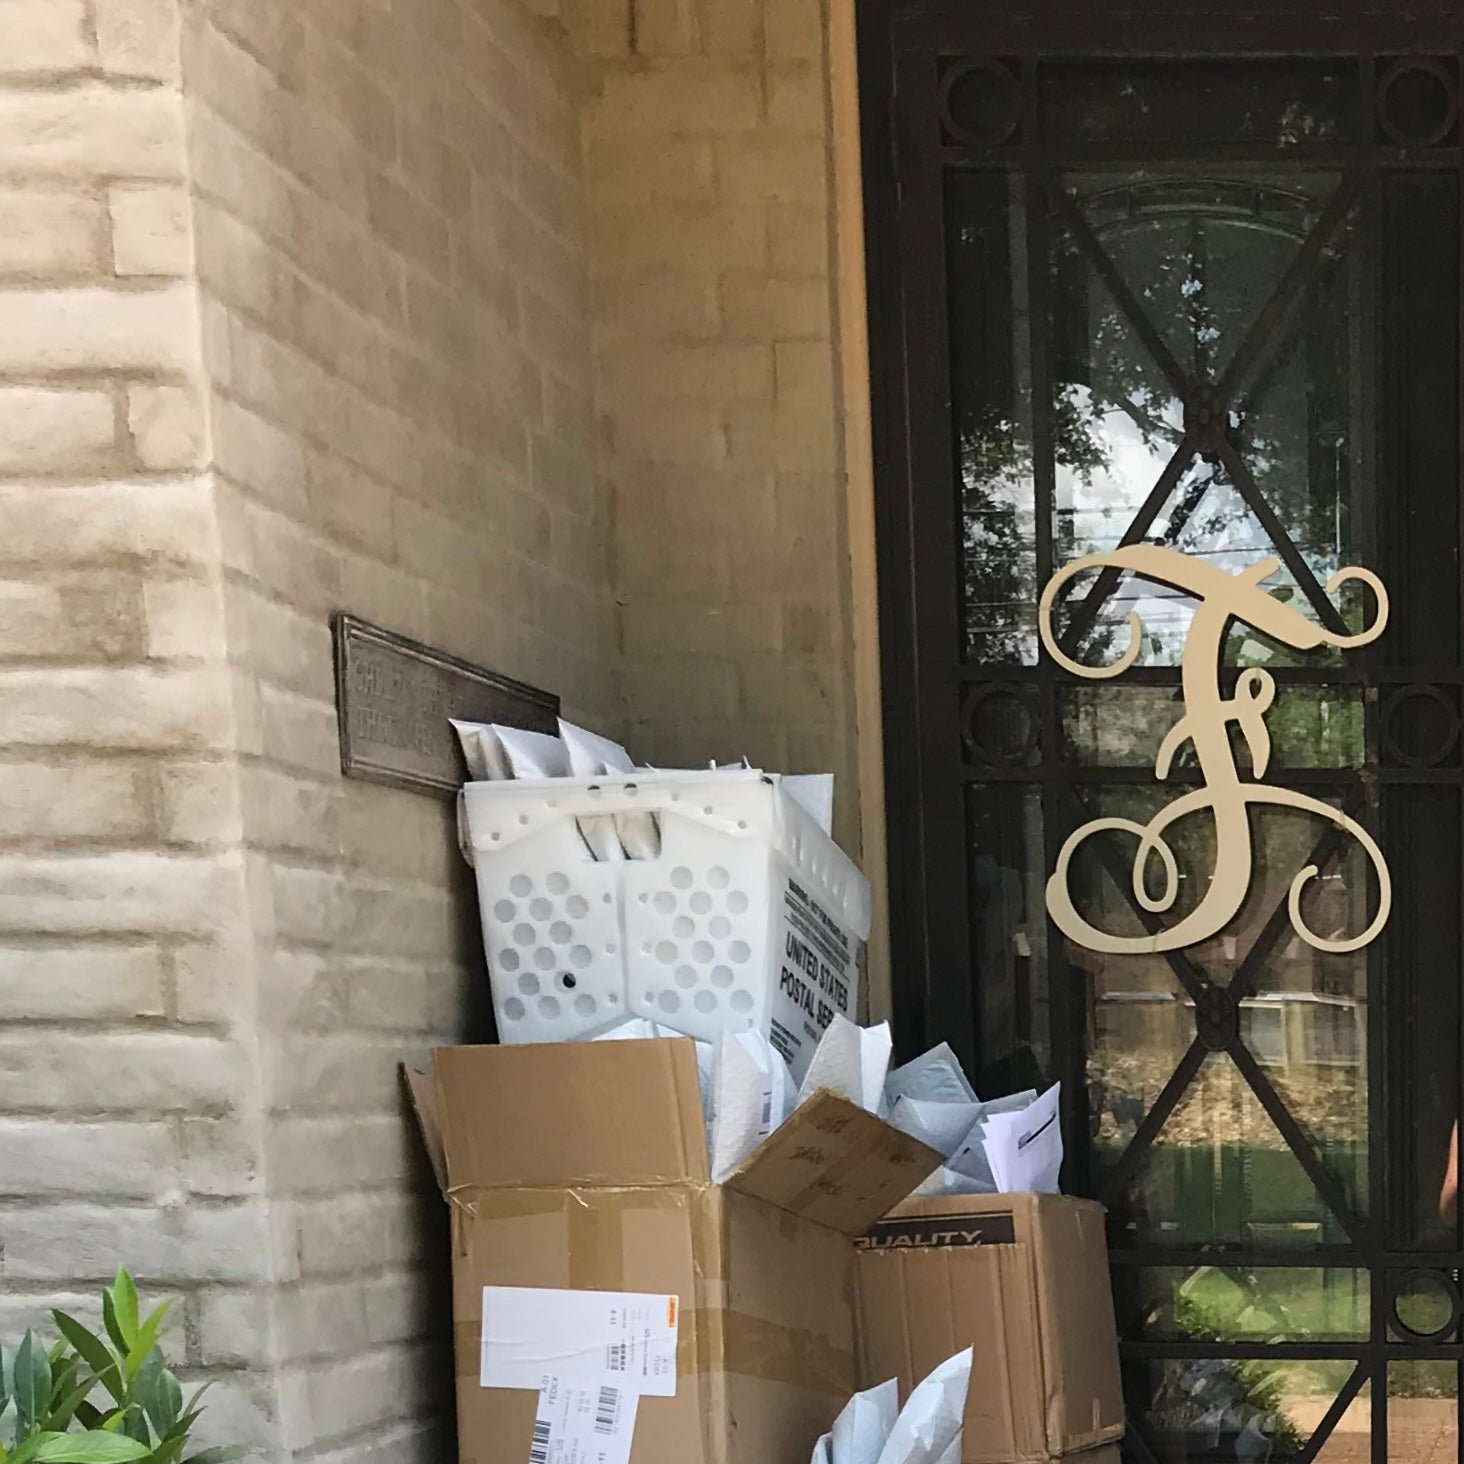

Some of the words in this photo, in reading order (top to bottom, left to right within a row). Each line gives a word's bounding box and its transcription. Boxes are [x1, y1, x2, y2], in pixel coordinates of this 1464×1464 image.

[779, 965, 815, 1018] POSTAL
[785, 931, 819, 981] UNITED
[820, 970, 849, 1012] STATES
